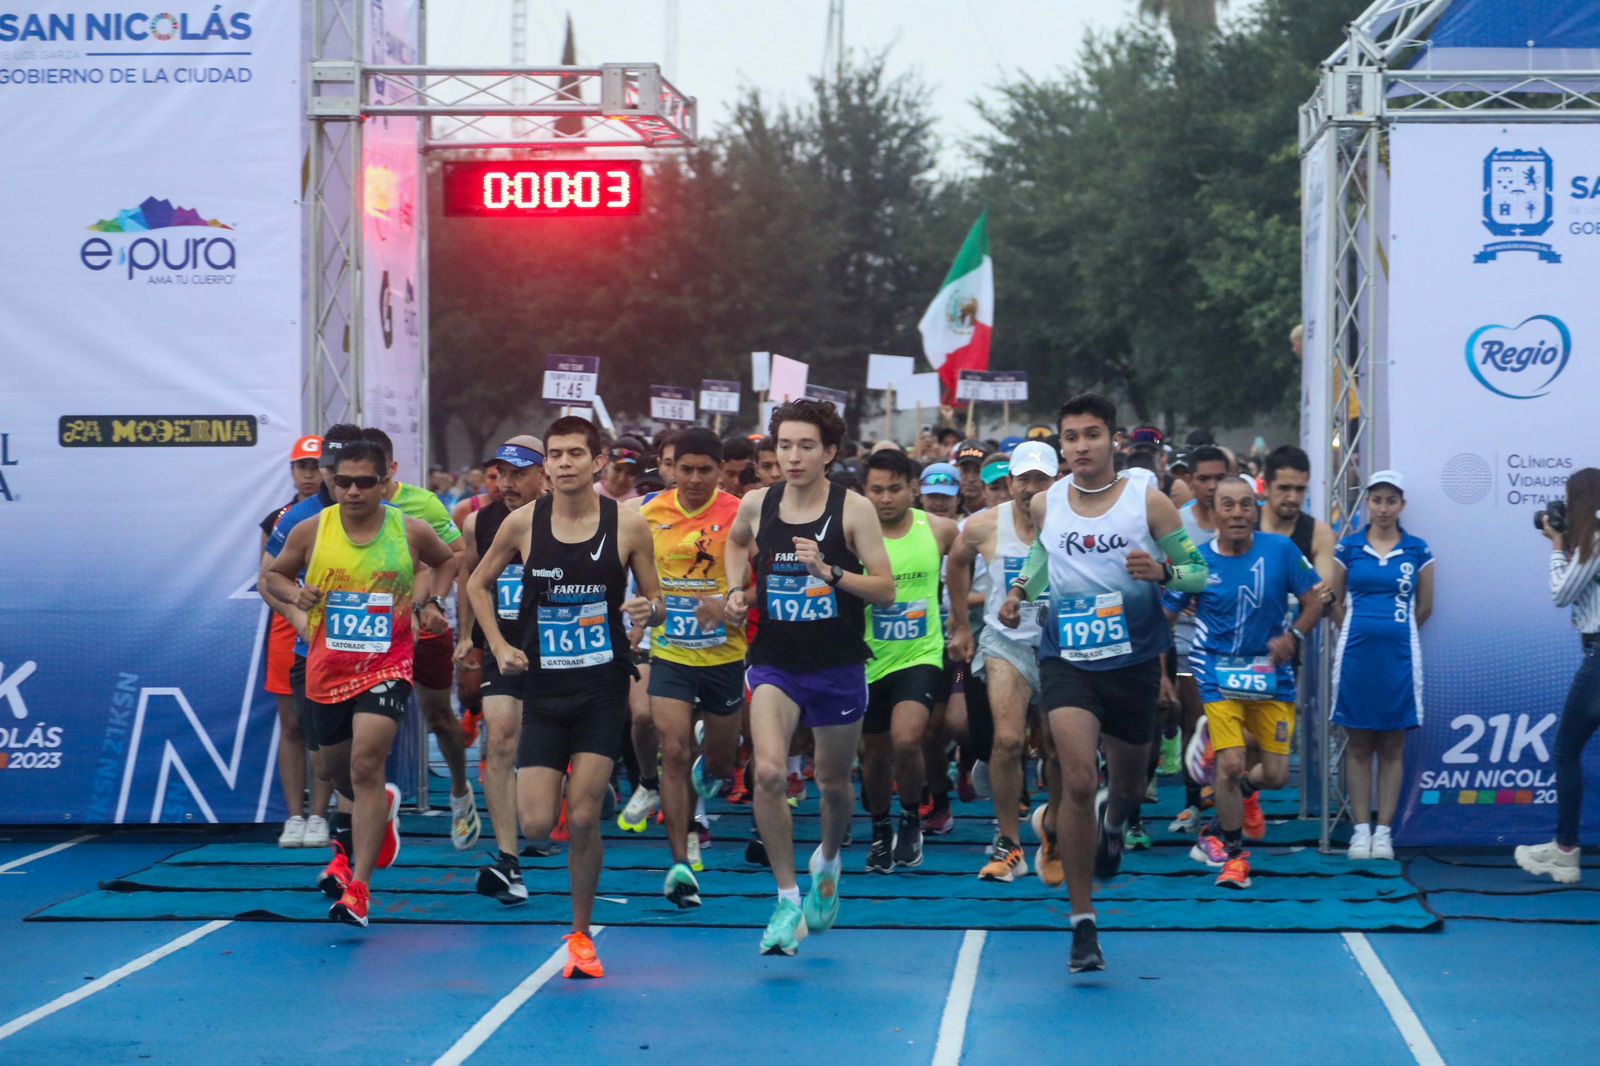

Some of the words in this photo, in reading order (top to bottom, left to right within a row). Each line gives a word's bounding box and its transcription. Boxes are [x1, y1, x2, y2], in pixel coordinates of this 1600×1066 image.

[0, 13, 75, 42] SAN
[86, 4, 253, 42] NICOLÁS
[0, 68, 104, 84] GOBIERNO
[110, 68, 137, 83] DE
[143, 68, 169, 83] LA
[174, 67, 253, 83] CIUDAD
[147, 275, 172, 285] AMA
[176, 275, 188, 285] TU
[191, 275, 233, 285] CUERPO
[1480, 340, 1558, 372] Regio
[555, 382, 583, 399] 1:45
[63, 420, 103, 442] LA
[112, 419, 253, 443] MODERNA
[302, 440, 319, 453] G
[1507, 453, 1573, 469] CLÍNICAS
[553, 584, 600, 594] FARTLEK
[772, 597, 833, 622] 1943
[330, 613, 389, 638] 1948
[880, 620, 920, 640] 705
[1063, 616, 1124, 647] 1995
[331, 641, 366, 650] GATORADE
[544, 624, 606, 653] 1613
[547, 658, 585, 666] GATORADE
[1228, 674, 1268, 692] 675
[1442, 712, 1557, 764] 21K
[8, 752, 63, 769] 2023
[1420, 770, 1470, 789] SAN
